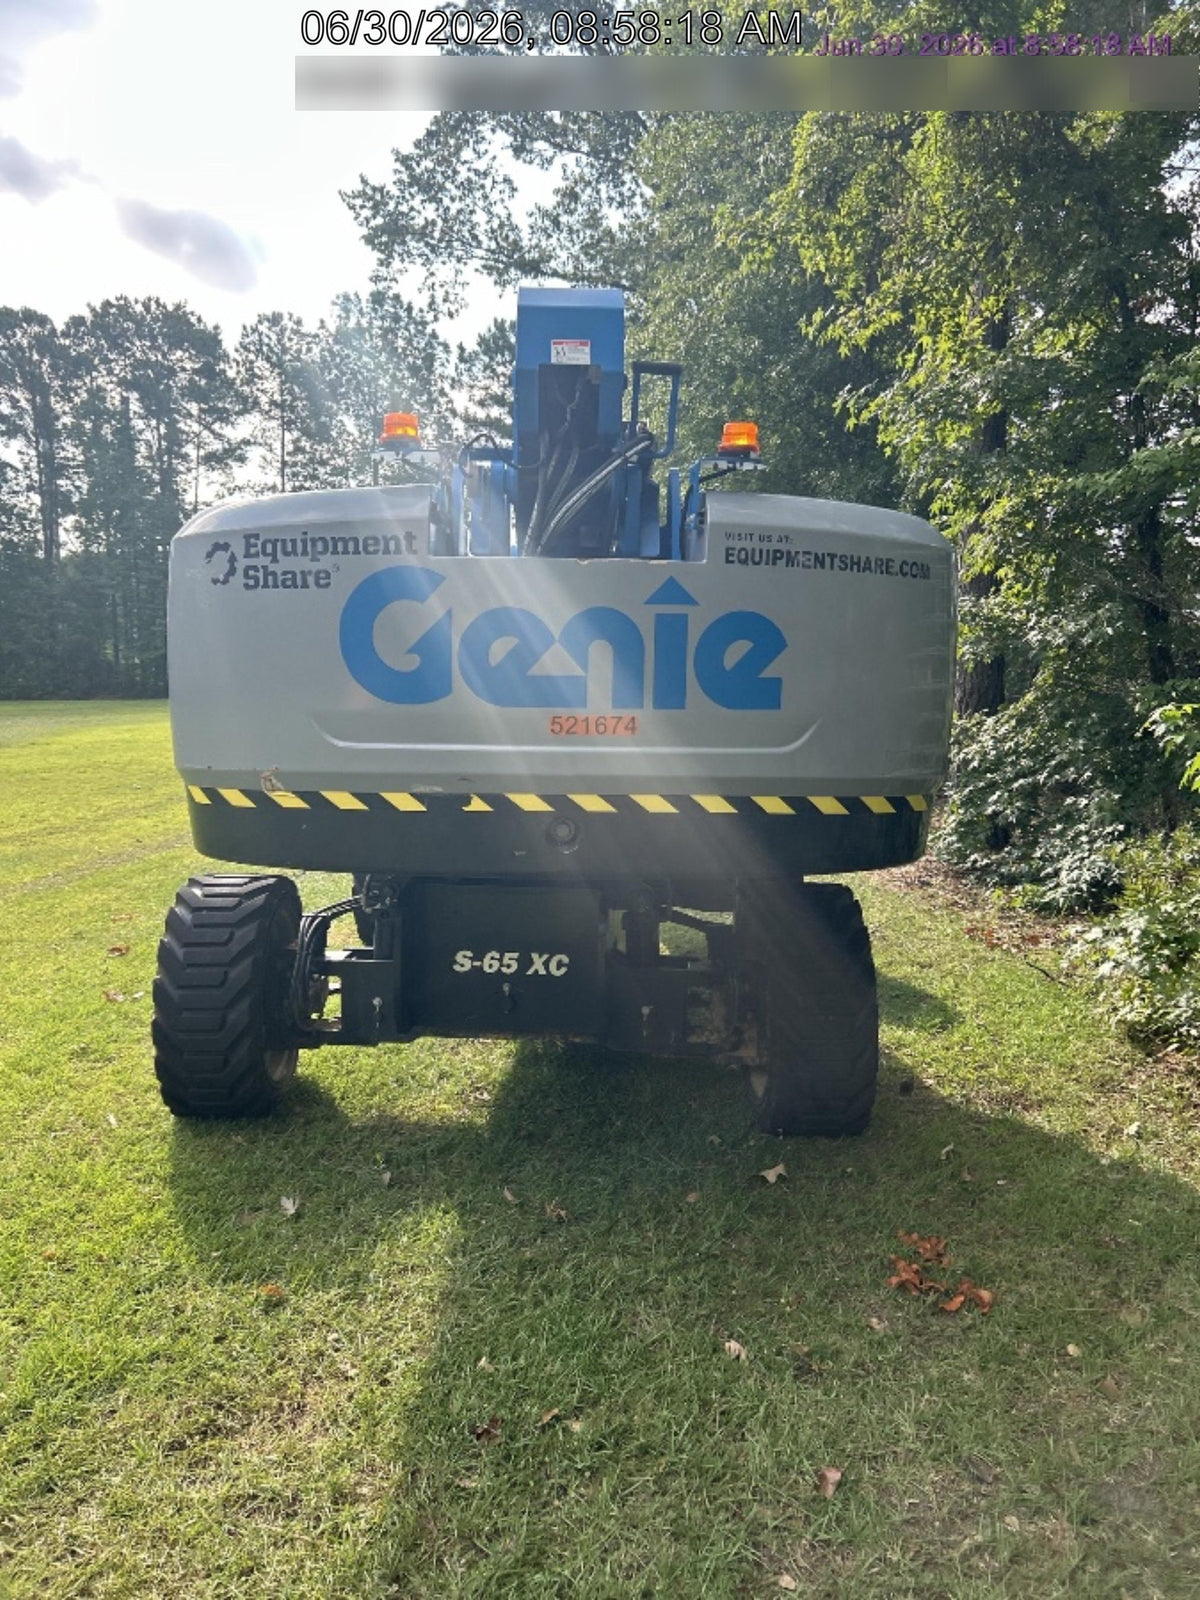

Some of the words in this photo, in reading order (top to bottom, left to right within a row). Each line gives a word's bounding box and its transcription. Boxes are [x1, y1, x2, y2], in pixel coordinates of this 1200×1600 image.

[242, 530, 418, 562] Equipment
[725, 531, 754, 542] VISIT
[759, 533, 773, 543] US
[725, 546, 931, 580] EQUIPMENTSHARE.COM
[339, 565, 788, 711] Genie
[550, 715, 637, 735] 521674
[452, 949, 520, 975] S-65
[525, 952, 570, 977] XC
